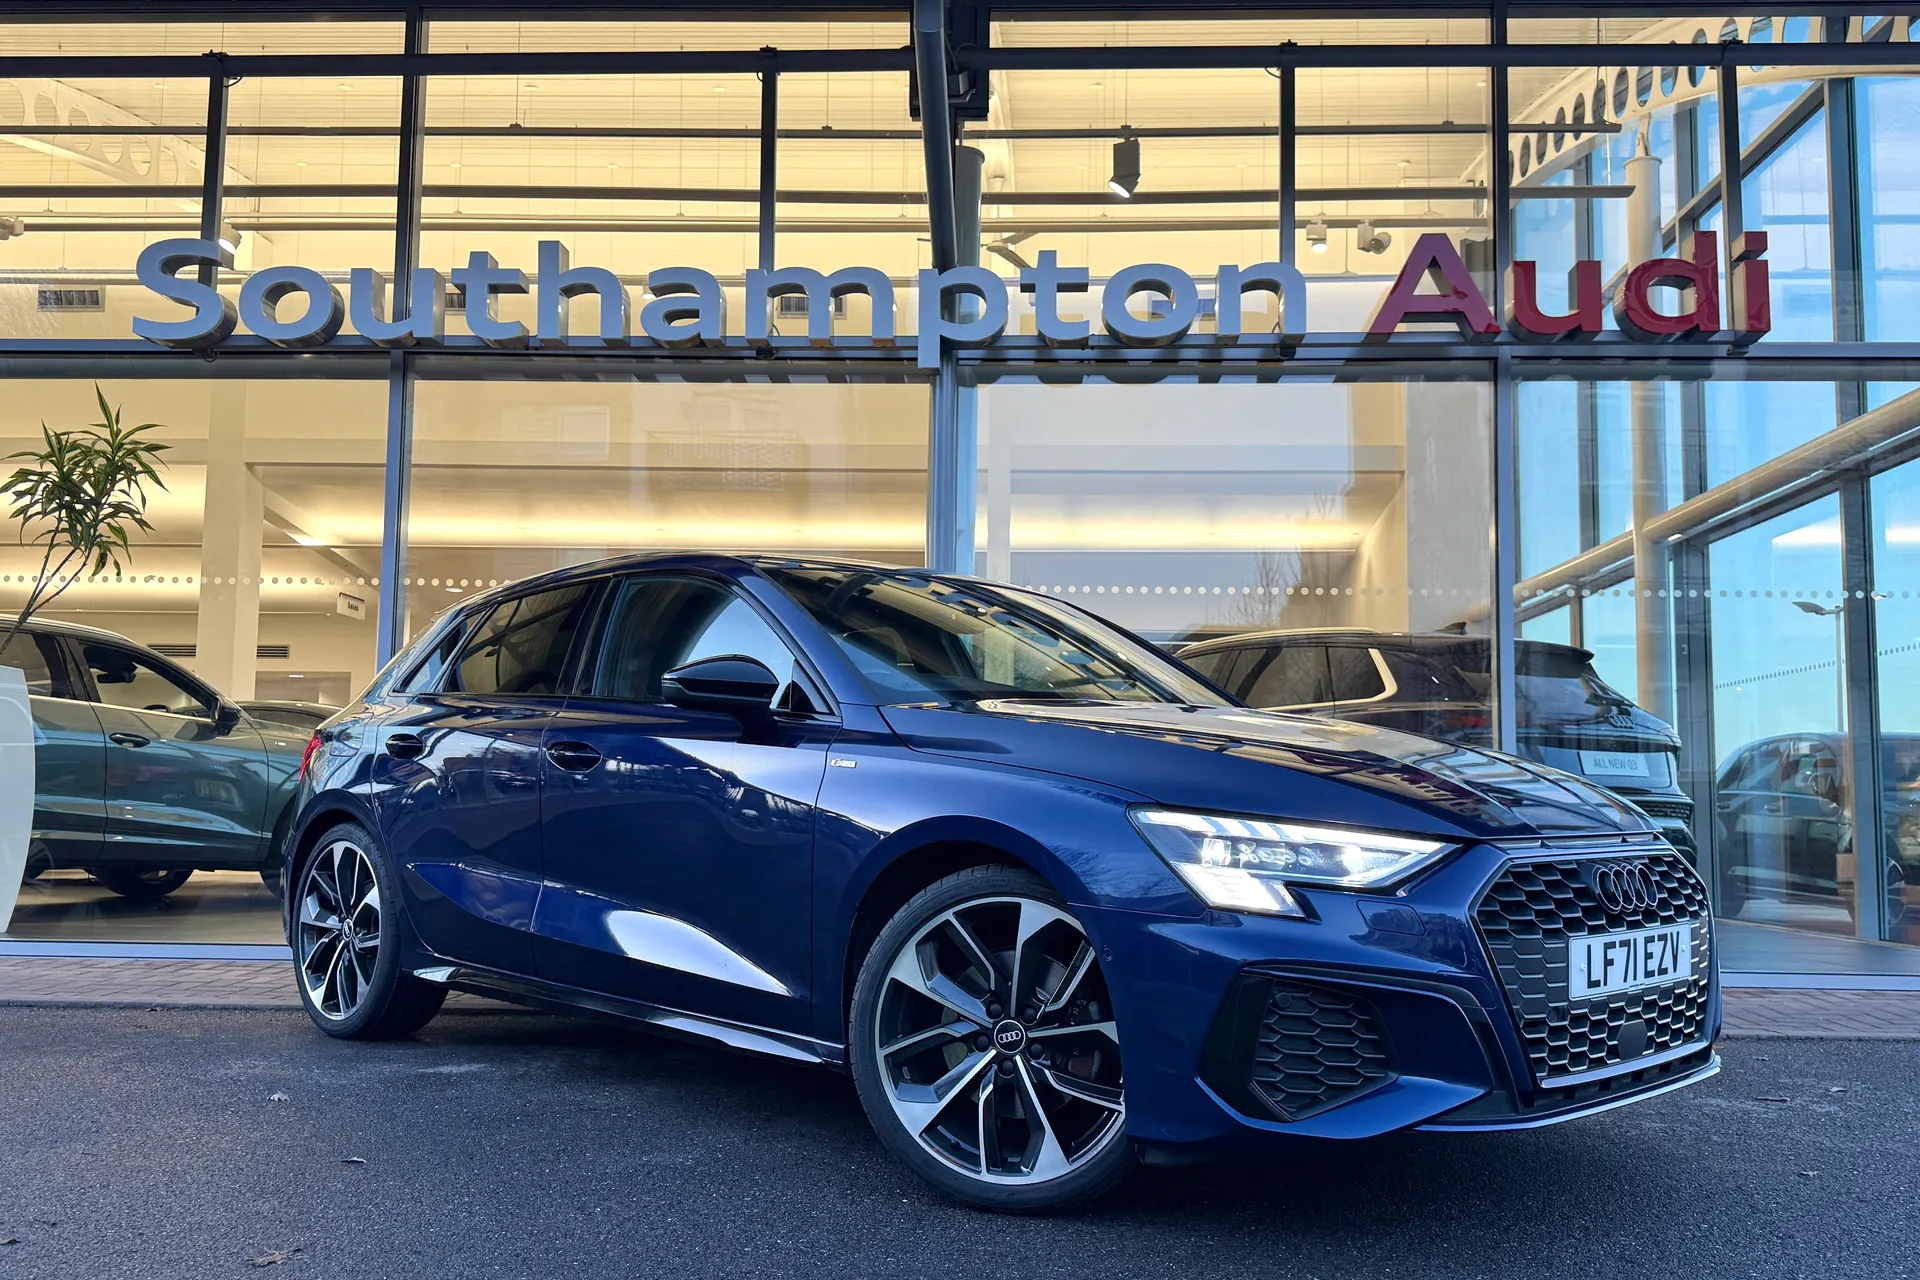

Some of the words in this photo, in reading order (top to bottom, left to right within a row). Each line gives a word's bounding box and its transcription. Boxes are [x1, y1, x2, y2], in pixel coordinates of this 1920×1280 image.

[132, 237, 1307, 370] Southampton
[1368, 230, 1771, 336] Audi
[347, 601, 359, 611] Sales
[1594, 758, 1607, 768] ALL
[1608, 759, 1626, 769] NEW
[1627, 758, 1637, 770] Q3
[1587, 937, 1638, 989] LF71
[1644, 931, 1680, 979] EZV
